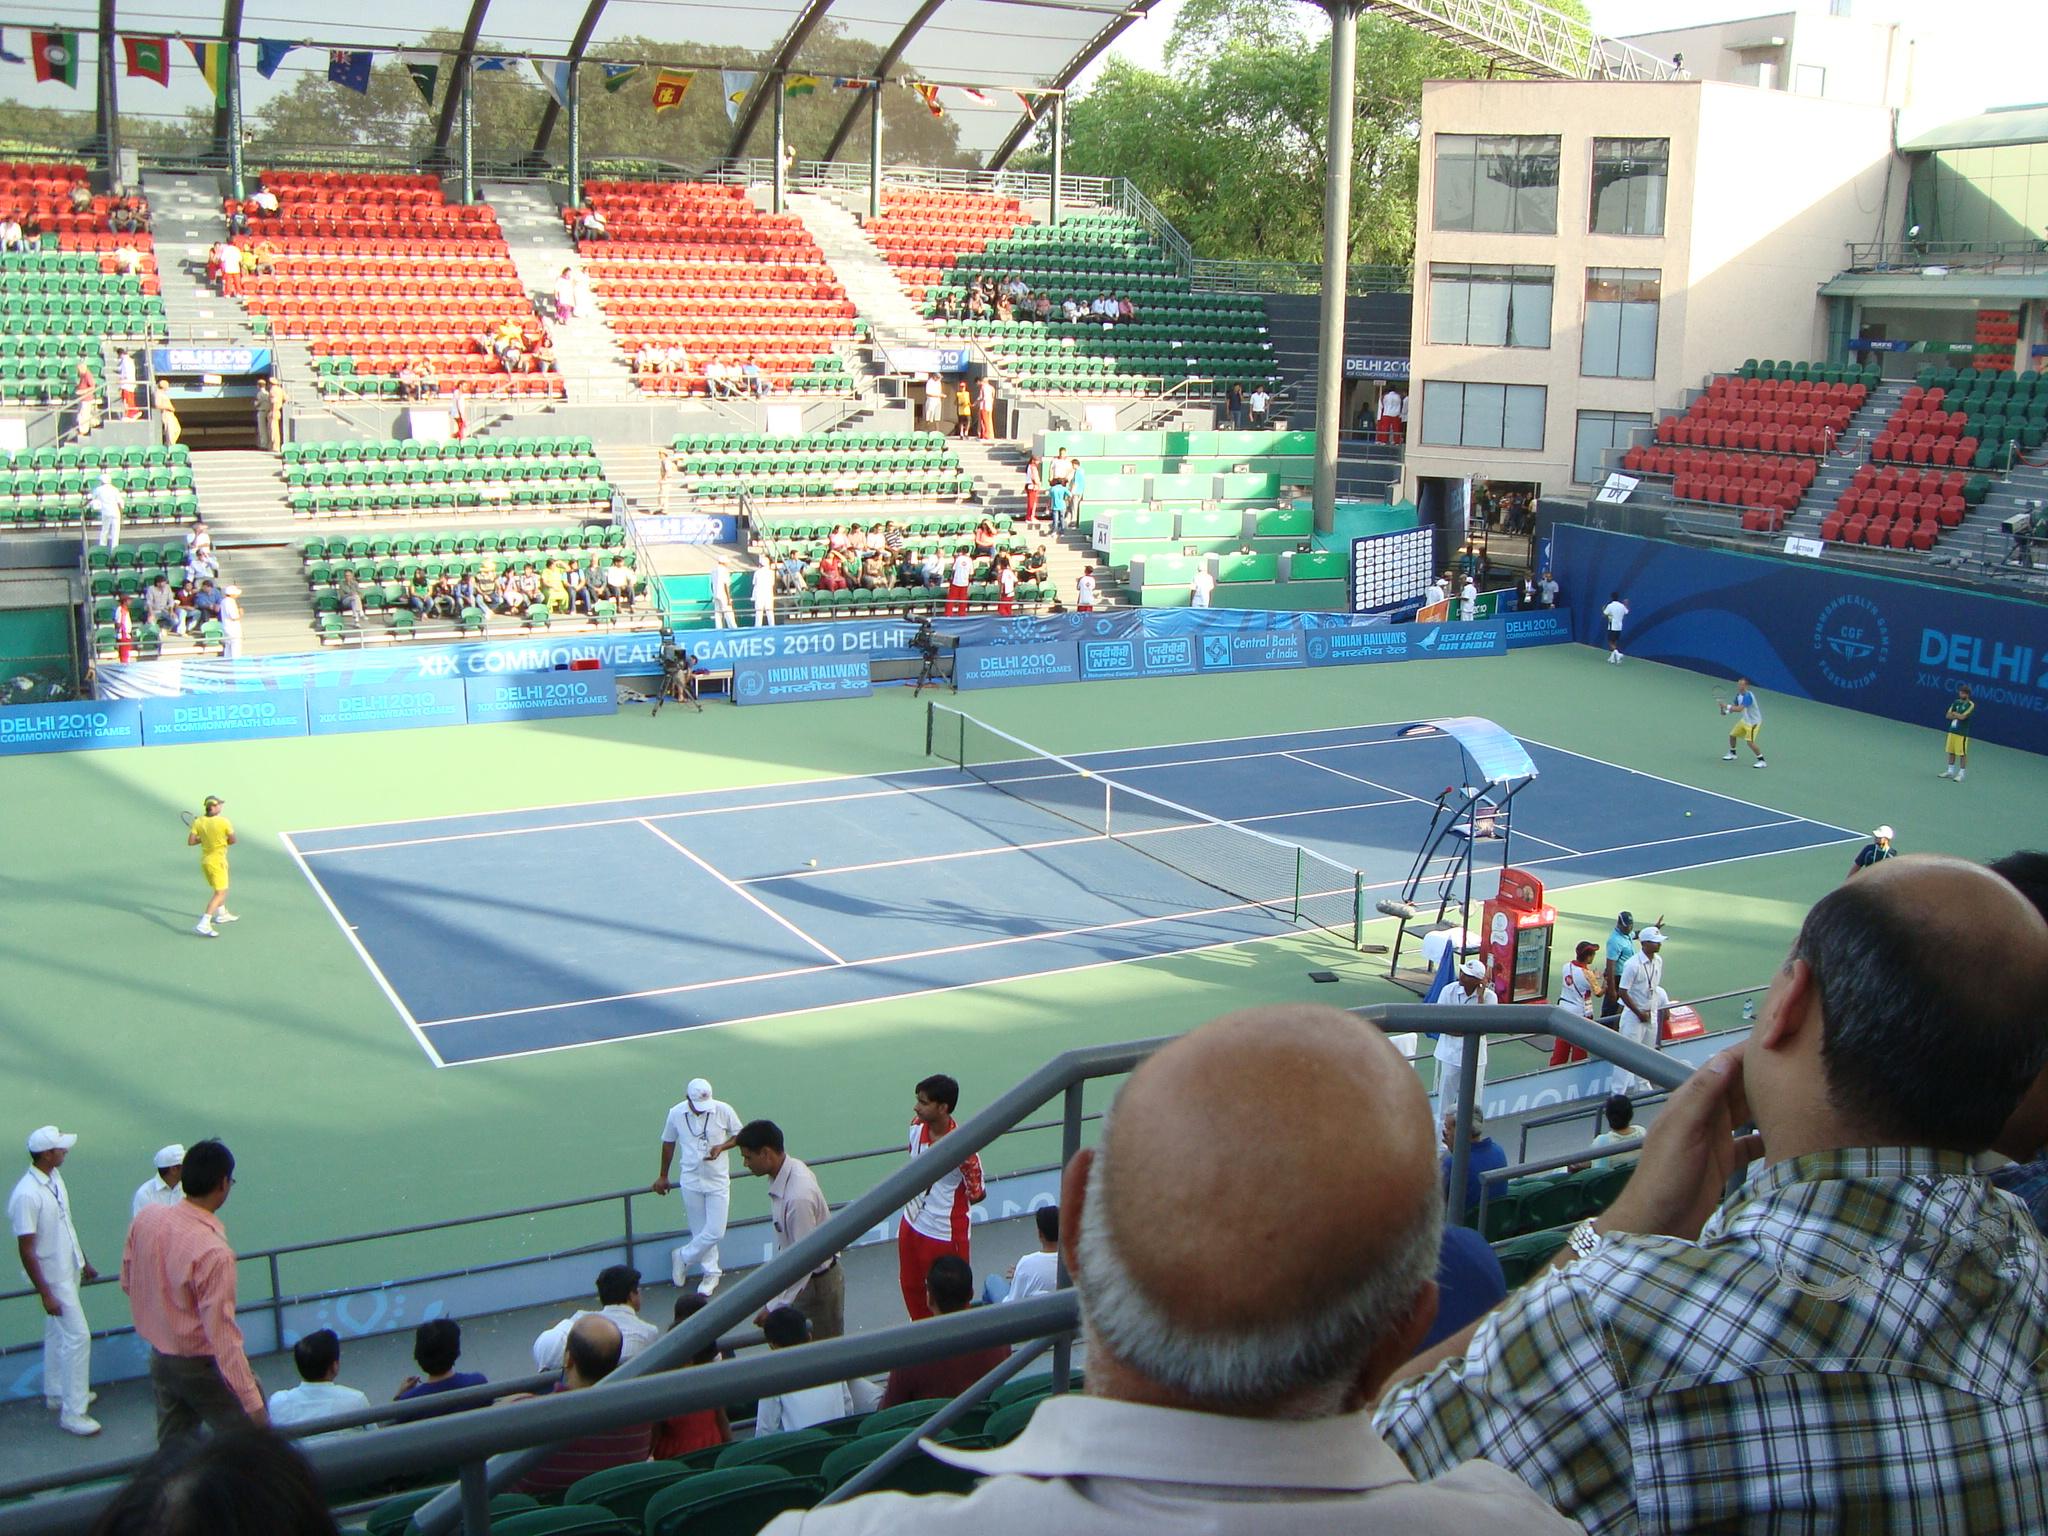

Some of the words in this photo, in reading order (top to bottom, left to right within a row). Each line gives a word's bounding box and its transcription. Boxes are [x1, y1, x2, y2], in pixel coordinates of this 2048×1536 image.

[233, 112, 241, 174] COMMOWEALTH
[214, 350, 253, 364] 2010
[1346, 359, 1382, 371] DELHI
[1098, 531, 1107, 545] A1
[1506, 620, 1533, 633] DELHI
[1533, 618, 1557, 631] 2010
[1233, 634, 1269, 649] Central
[1272, 633, 1298, 647] Bank
[1331, 633, 1362, 648] INDIAN
[1363, 631, 1407, 646] RAILWAYS
[1438, 642, 1459, 651] AIR
[1460, 641, 1494, 650] INDIA
[417, 655, 460, 677] XIX
[467, 643, 685, 673] COMMONWEAL
[694, 637, 776, 660] GAMES
[783, 633, 835, 655] 2010
[842, 630, 904, 651] DELHI
[1151, 654, 1185, 665] NTPC
[1265, 648, 1275, 659] of
[1277, 648, 1298, 658] India
[1332, 646, 1384, 658] भारतीय
[1386, 645, 1407, 655] रेल
[1920, 627, 2033, 685] DELHI
[981, 655, 1019, 671] DELHI
[1021, 653, 1056, 668] 2010
[1093, 657, 1127, 668] NTPC
[767, 666, 809, 682] INDIAN
[811, 662, 868, 680] RAILWAYS
[966, 671, 979, 680] XIX
[980, 667, 1045, 679] COMMONWEALTH
[1046, 665, 1072, 674] GAMES
[1818, 660, 1878, 689] FEDERATION
[1916, 671, 1941, 689] XIX
[495, 685, 543, 701] DELHI
[545, 682, 588, 699] 2010
[769, 680, 837, 695] भारतीय
[840, 678, 870, 690] रेल
[338, 695, 389, 713] DELHI
[391, 692, 436, 709] 2010
[495, 697, 574, 711] COMMONWEALTH
[576, 695, 608, 705] GAMES
[174, 705, 226, 724] DELHI
[228, 702, 277, 720] 2010
[338, 707, 422, 722] COMMONWEALTH
[1, 715, 56, 734] DELHI
[58, 712, 108, 730] 2010
[173, 718, 261, 733] COMMONWEALTH
[262, 716, 298, 727] GAMES
[0, 729, 92, 743] COMMONWEALTH
[94, 726, 131, 737] GAMES
